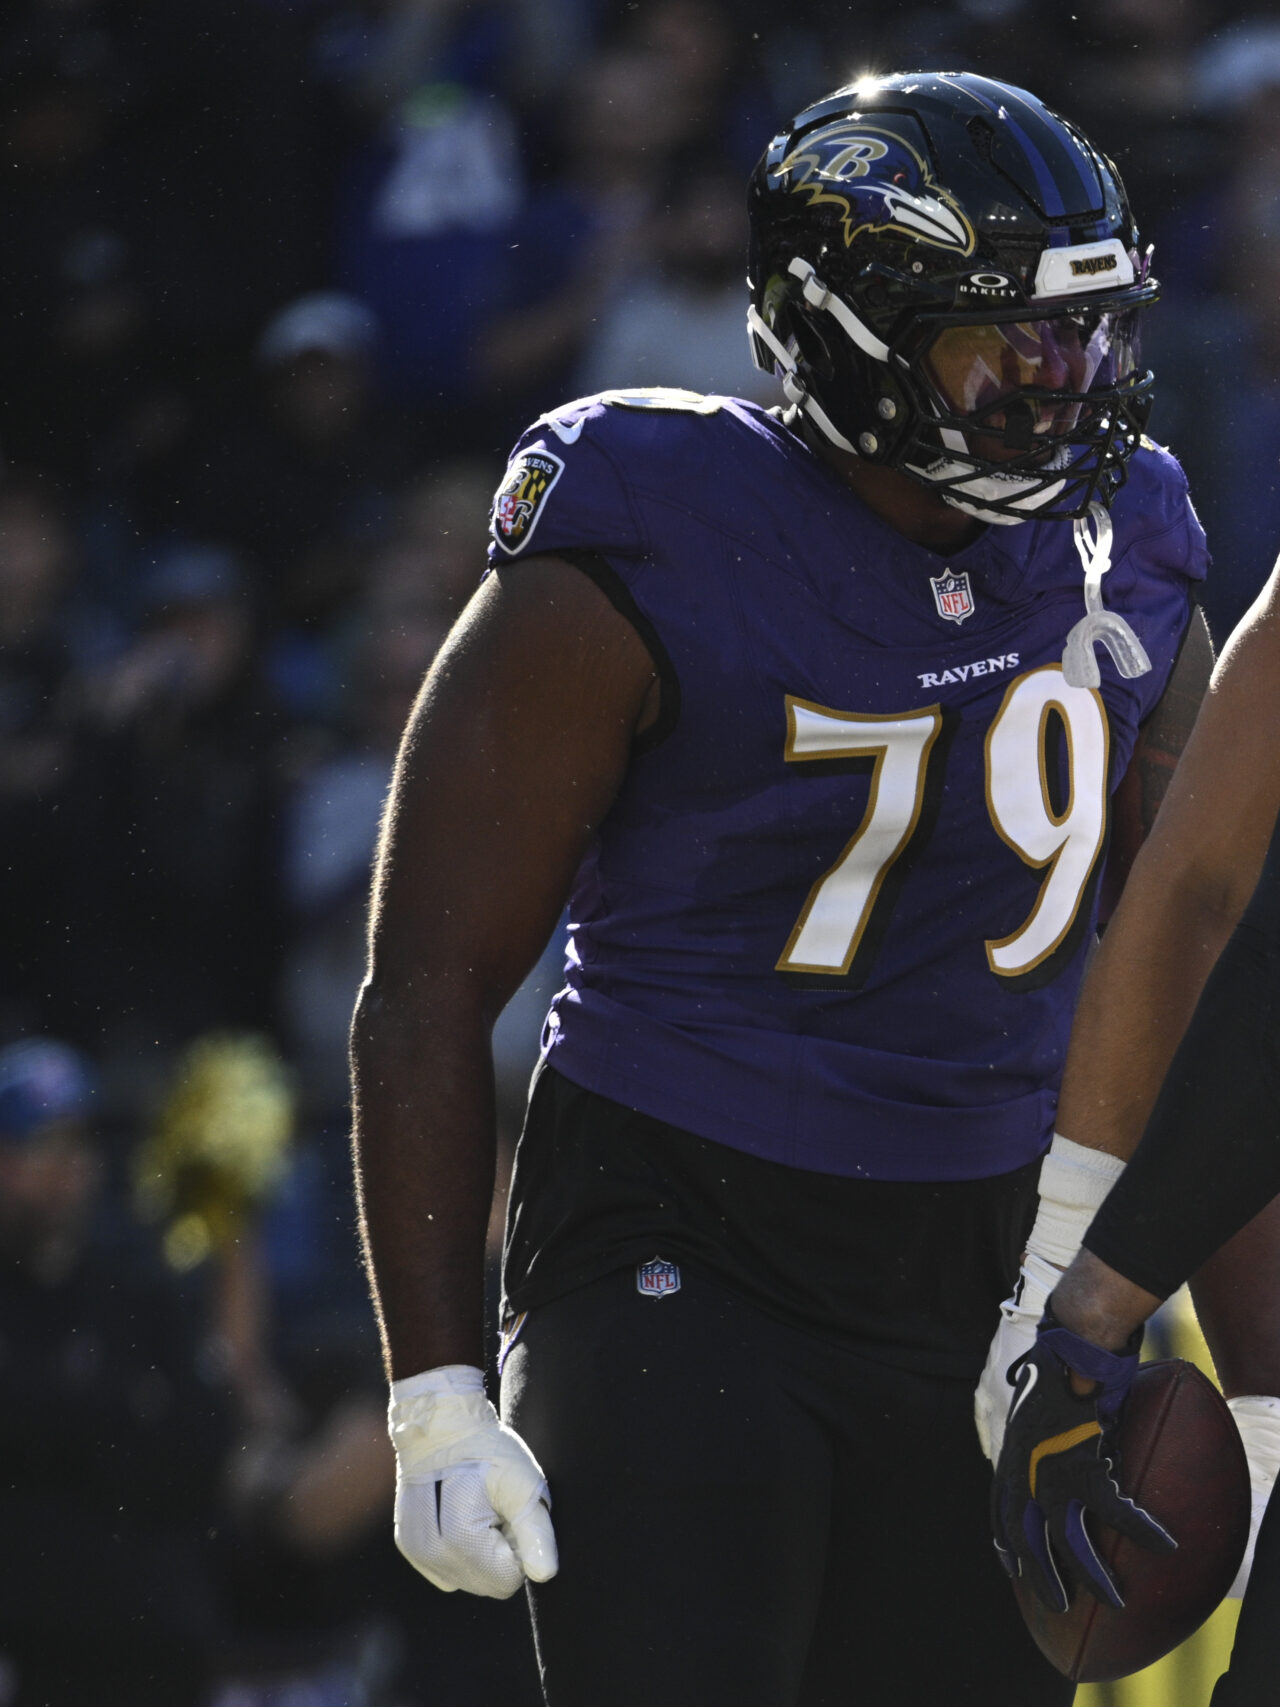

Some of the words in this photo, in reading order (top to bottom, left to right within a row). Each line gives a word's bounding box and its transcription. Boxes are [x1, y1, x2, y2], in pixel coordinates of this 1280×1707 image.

[818, 136, 889, 183] B
[1069, 254, 1117, 276] RAVENS
[960, 285, 1016, 298] OAKLEY
[941, 593, 969, 614] NFL
[917, 653, 1019, 688] RAVENS
[775, 661, 1110, 977] 79
[644, 1274, 674, 1289] NFL
